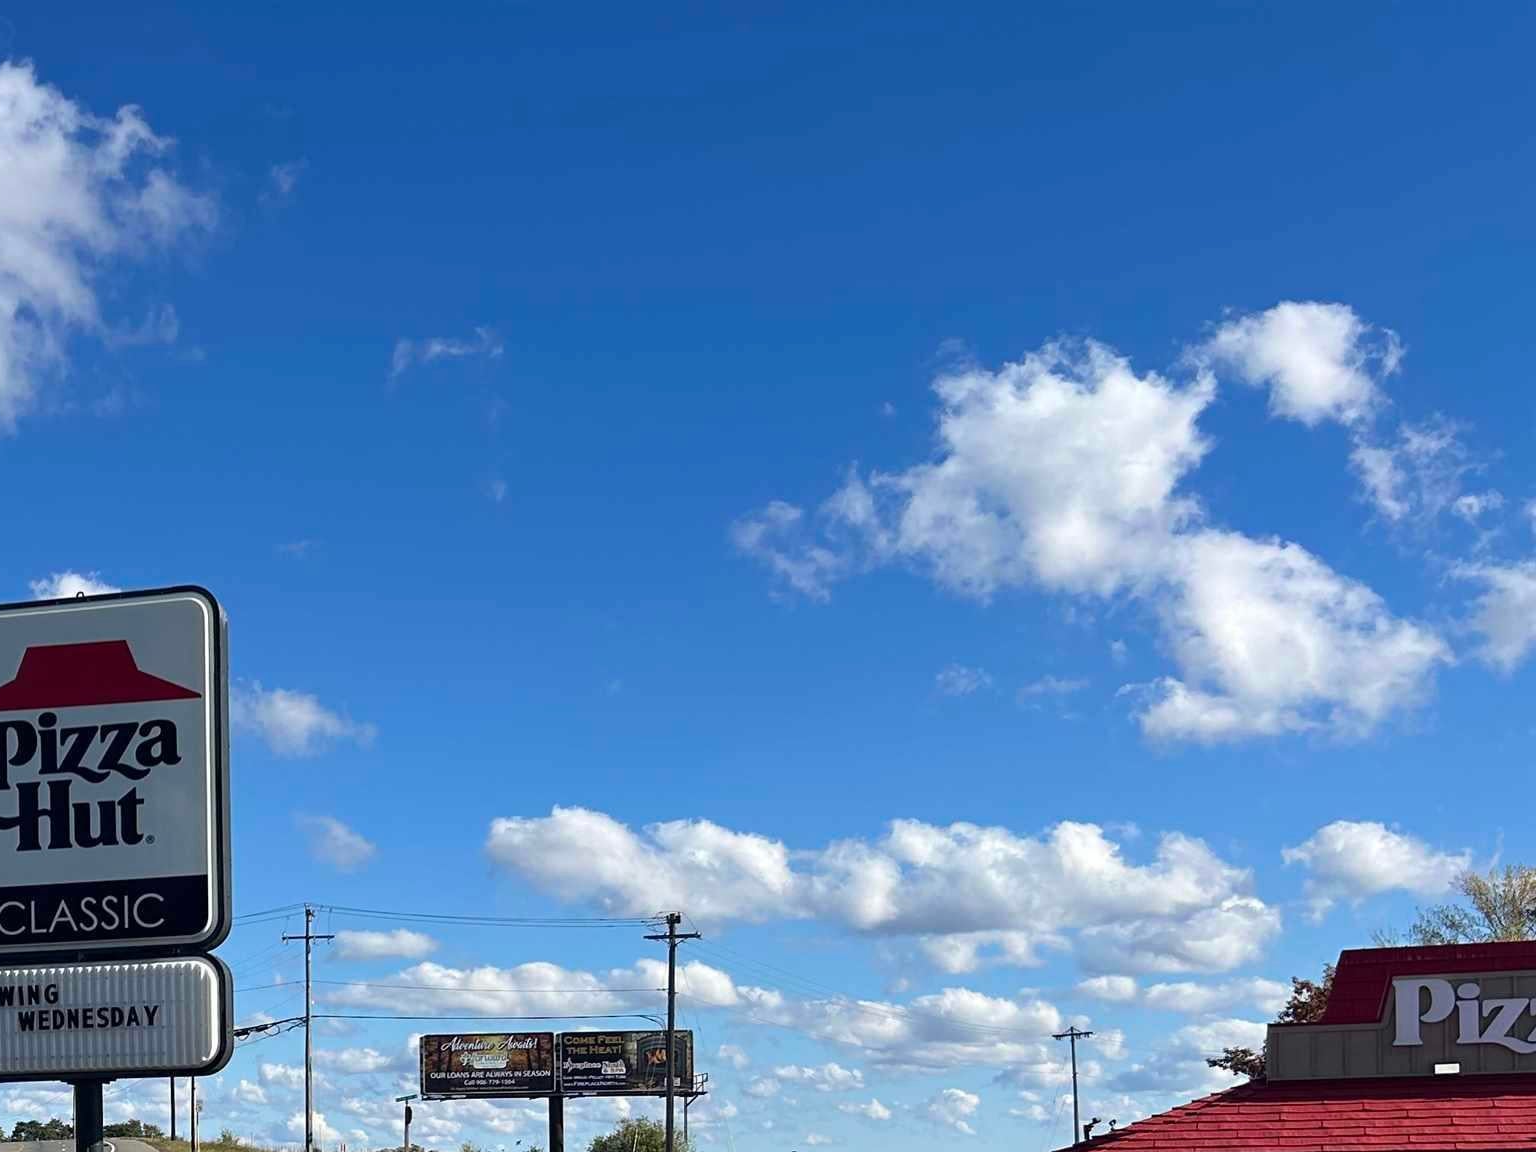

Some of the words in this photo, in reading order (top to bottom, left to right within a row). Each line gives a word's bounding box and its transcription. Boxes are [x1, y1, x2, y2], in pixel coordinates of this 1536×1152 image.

[17, 1005, 160, 1033] WEDNESDAY
[1391, 978, 1536, 1055] Piz
[440, 1036, 494, 1052] Adventure
[497, 1035, 539, 1051] Awaits!
[565, 1036, 597, 1045] COME
[599, 1035, 625, 1044] FEEL
[566, 1047, 588, 1055] THE
[589, 1045, 622, 1055] HEAT!
[447, 1071, 470, 1079] LOANS
